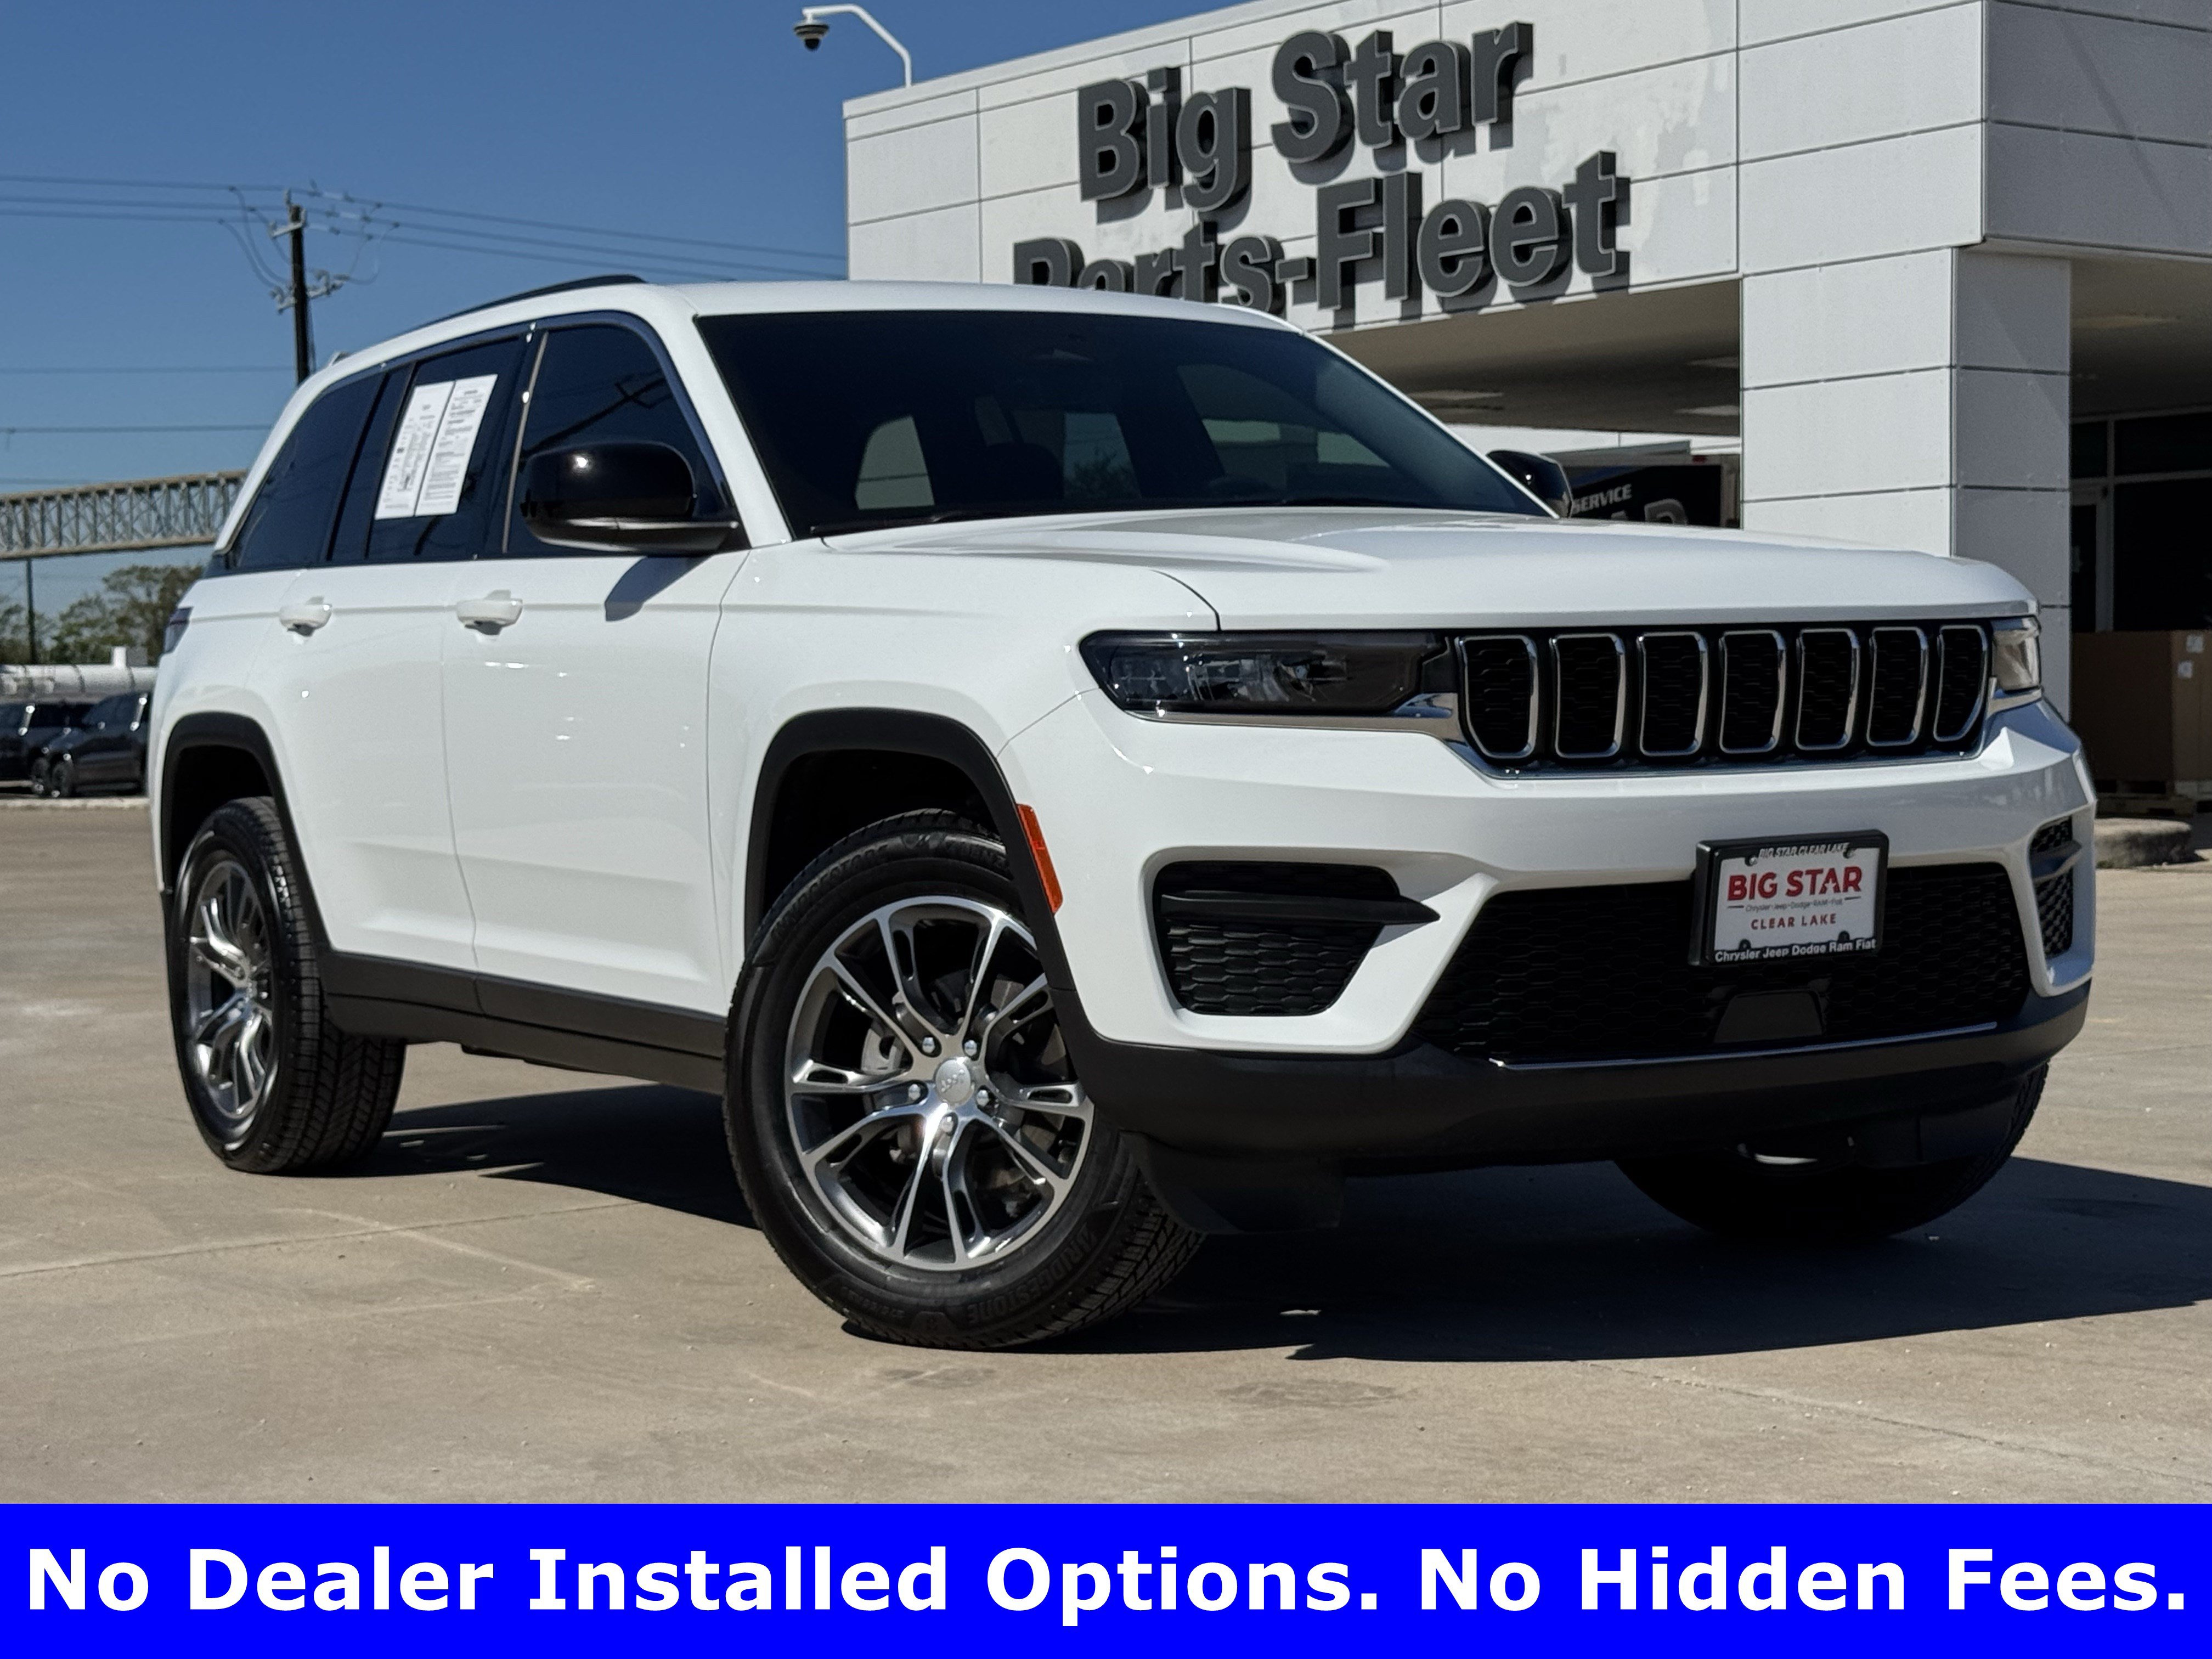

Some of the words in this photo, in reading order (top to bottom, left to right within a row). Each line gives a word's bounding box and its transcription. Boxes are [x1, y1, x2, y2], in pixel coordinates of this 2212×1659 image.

[1078, 67, 1251, 212] Big
[1272, 22, 1534, 164] Star
[1572, 483, 1632, 515] SERVICE
[1775, 846, 1798, 857] STAR
[1798, 843, 1827, 856] CLEAR
[1827, 842, 1850, 853] LAKE
[1727, 872, 1778, 901] BIG
[1785, 866, 1863, 897] STAR
[1751, 916, 1795, 930] CLEAR
[1801, 913, 1837, 926] LAKE
[1714, 949, 1760, 963] Chrysler
[1763, 947, 1789, 958] Jeep
[1792, 943, 1826, 956] Dodge
[1829, 941, 1853, 952] Ram
[1856, 938, 1876, 950] Fiat
